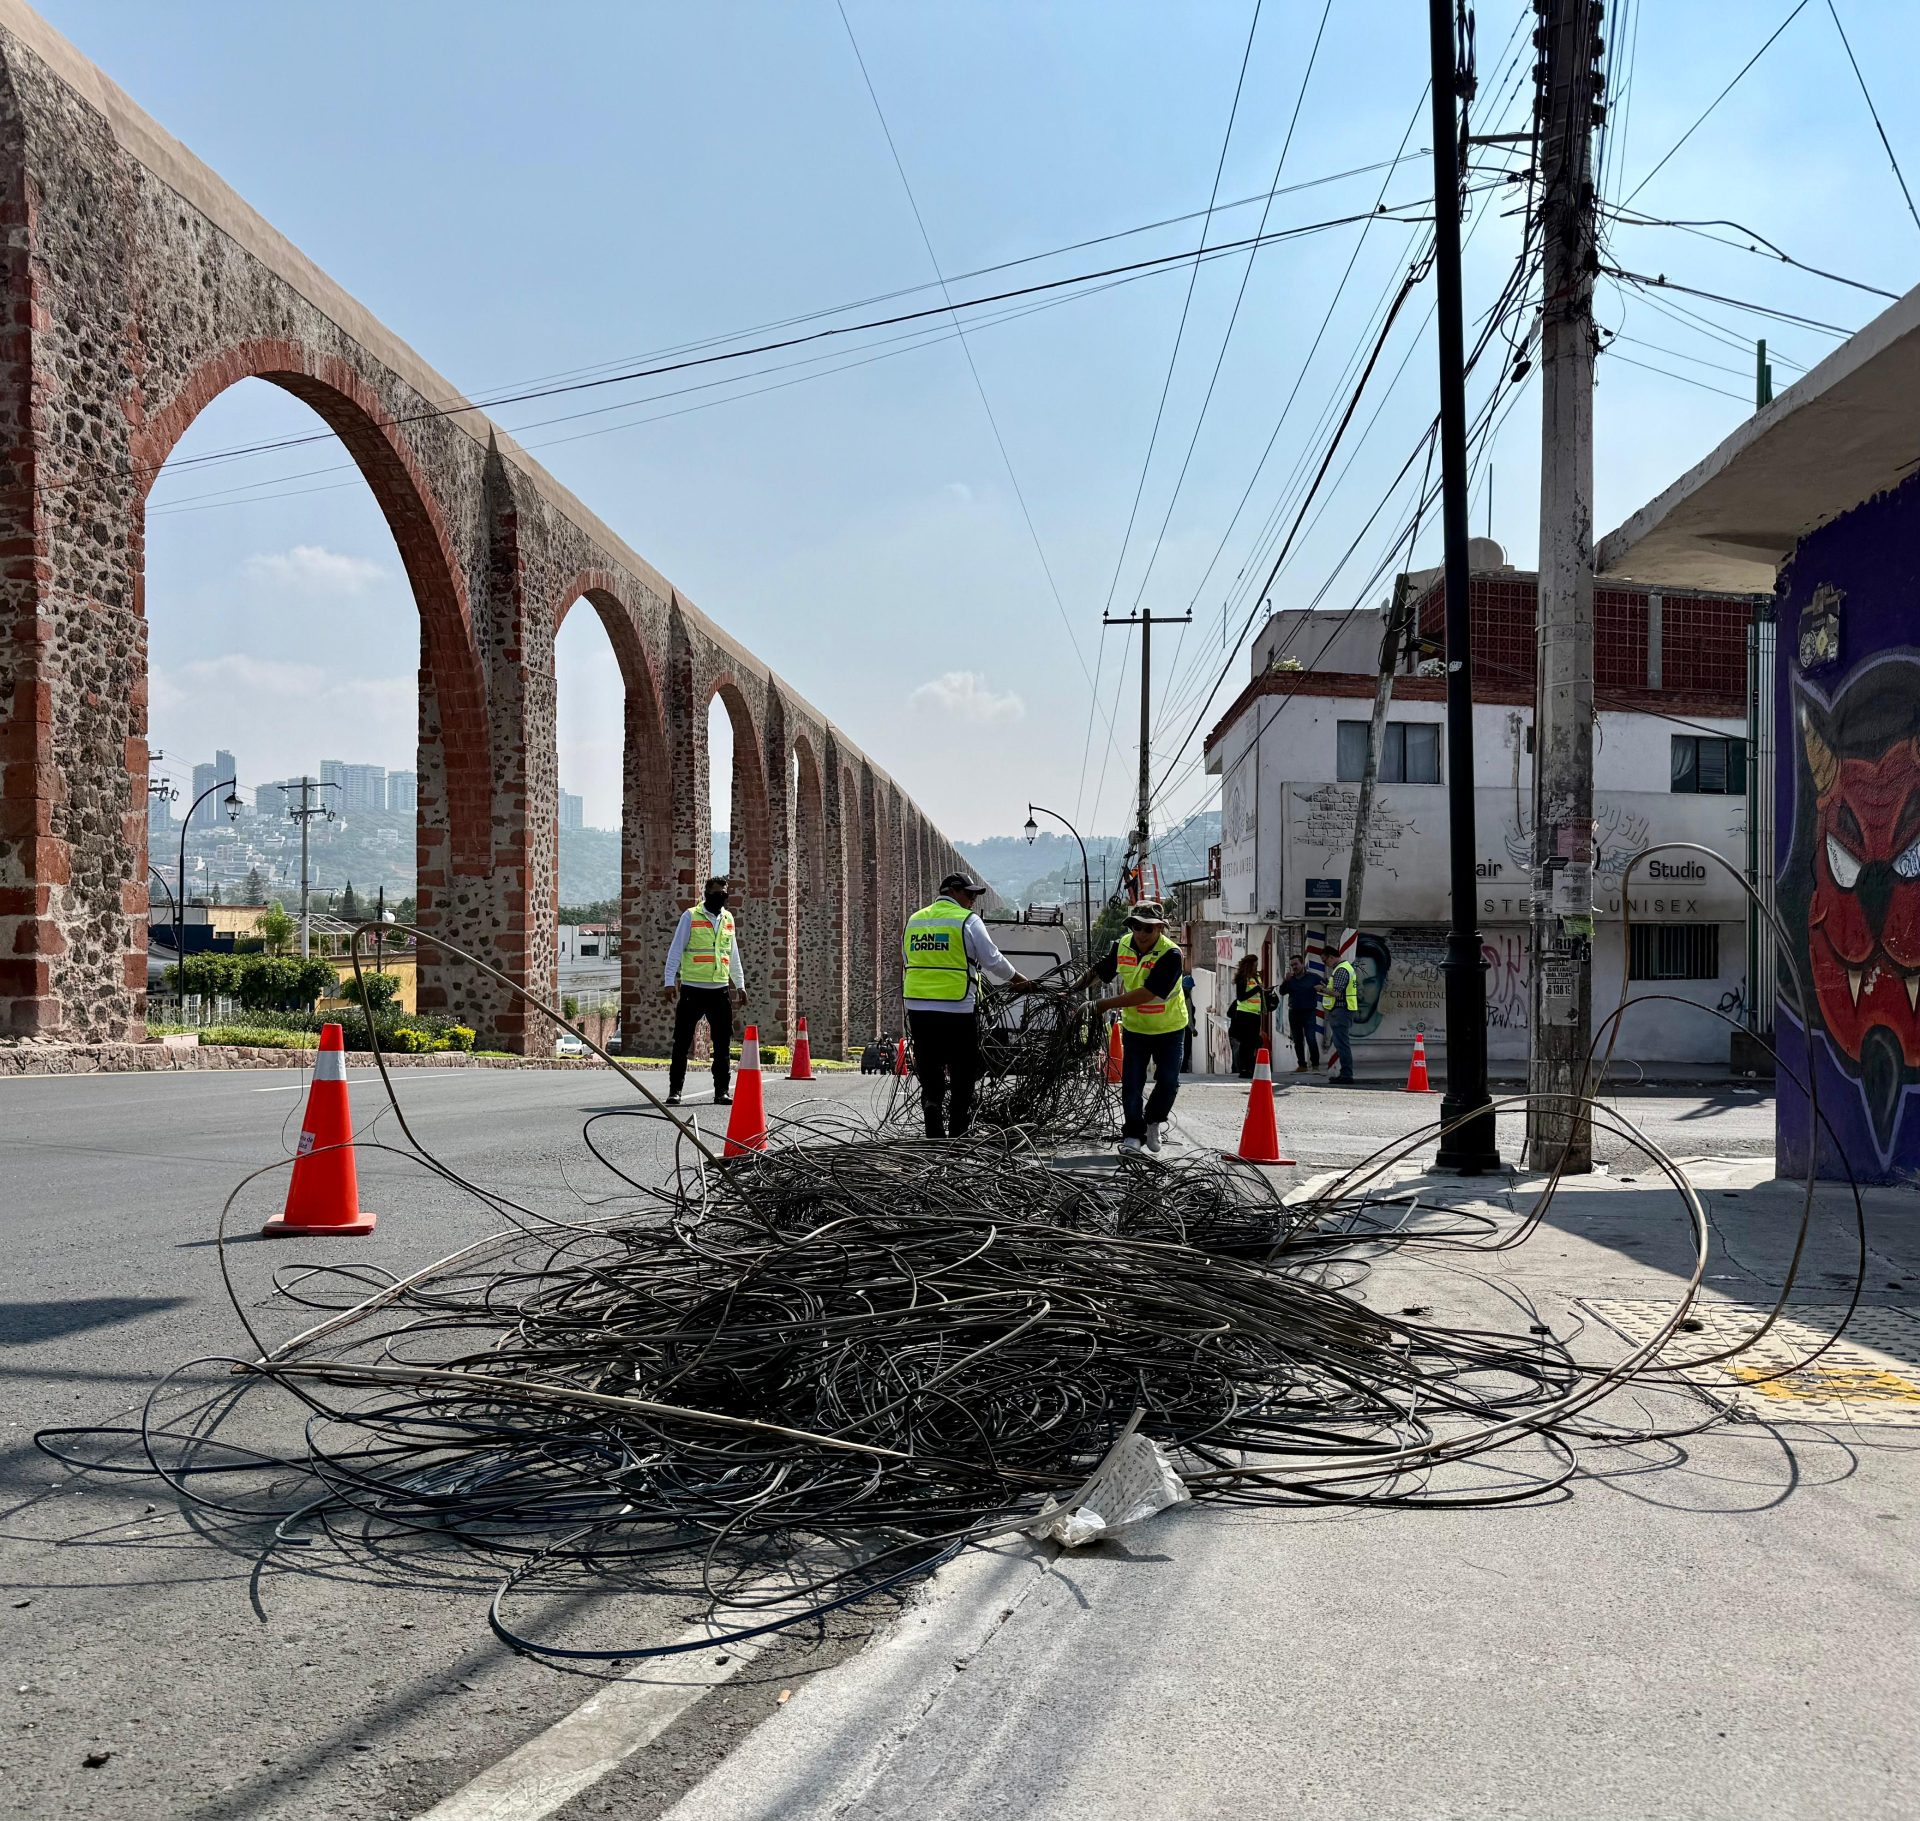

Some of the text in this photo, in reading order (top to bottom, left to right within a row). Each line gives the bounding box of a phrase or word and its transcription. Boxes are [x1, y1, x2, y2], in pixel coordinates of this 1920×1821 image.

[1476, 858, 1706, 879] air Studio
[1609, 899, 1698, 913] UNISEX
[911, 933, 935, 943] PLAN
[914, 942, 949, 951] ORDEN
[1406, 1001, 1440, 1009] IMAGEN
